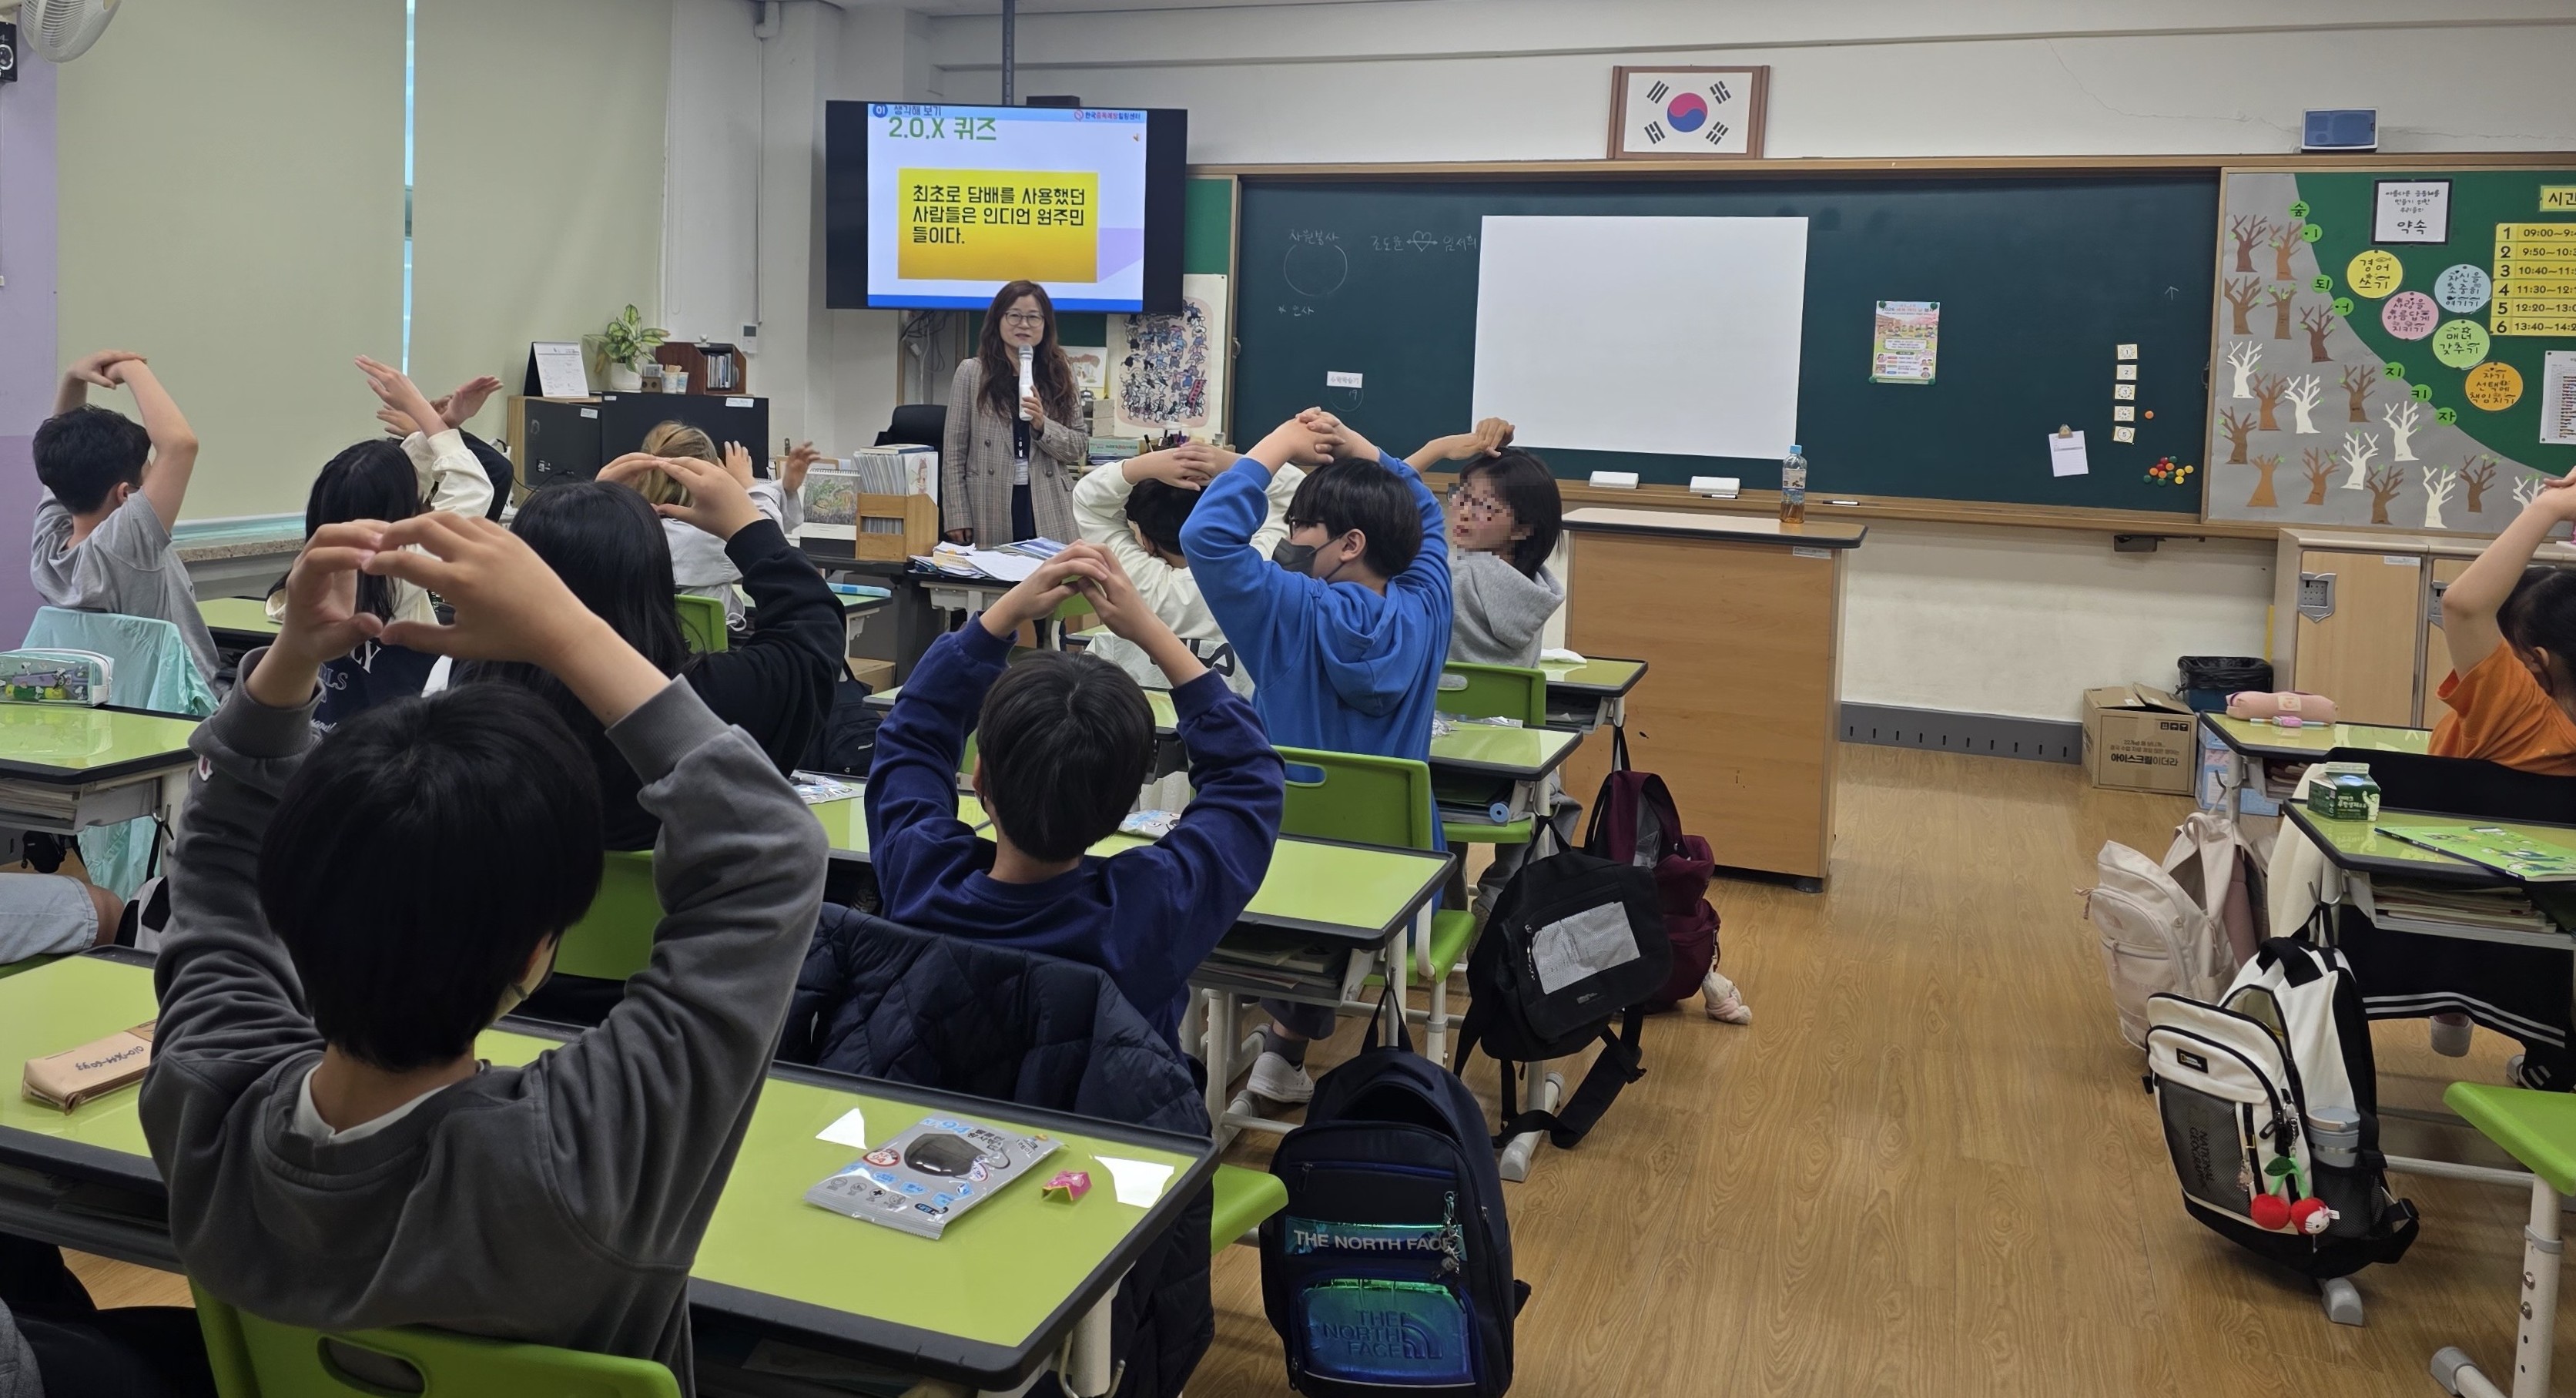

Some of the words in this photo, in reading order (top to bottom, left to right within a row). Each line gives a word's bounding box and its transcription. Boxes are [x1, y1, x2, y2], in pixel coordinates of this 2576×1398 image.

[893, 105, 921, 116] 생각해
[923, 106, 942, 116] 보기
[953, 117, 997, 140] 퀴즈
[913, 184, 961, 203] 최초로
[968, 186, 1015, 204] 담배를
[1022, 187, 1085, 206] 사용했던
[2548, 192, 2576, 206] 시간
[913, 206, 976, 224] 사람들은
[983, 207, 1030, 225] 인디언
[1037, 208, 1084, 226] 원주민
[2397, 220, 2427, 234] 약속
[2503, 226, 2511, 240] 1
[913, 226, 965, 244] 들이다.
[2501, 246, 2511, 258] 2
[2360, 259, 2390, 272] 경어
[2501, 264, 2511, 277] 3
[2519, 267, 2576, 275] 10:40~11:
[2359, 278, 2388, 289] 쓰기
[2449, 271, 2481, 283] 자신을
[2447, 284, 2480, 295] 소중히
[2498, 283, 2510, 297] 4
[2393, 298, 2425, 310] 사랑을
[2497, 302, 2508, 314] 5
[2387, 310, 2430, 321] 아름답게
[2497, 320, 2507, 334] 6
[2440, 342, 2478, 355] 갖추기
[2477, 381, 2510, 391] 선택에
[1294, 1229, 1329, 1248] THE
[1335, 1235, 1402, 1251] NORTH
[1356, 1310, 1401, 1328] THE
[1323, 1323, 1402, 1343] NORTH
[1348, 1343, 1402, 1357] FACE
